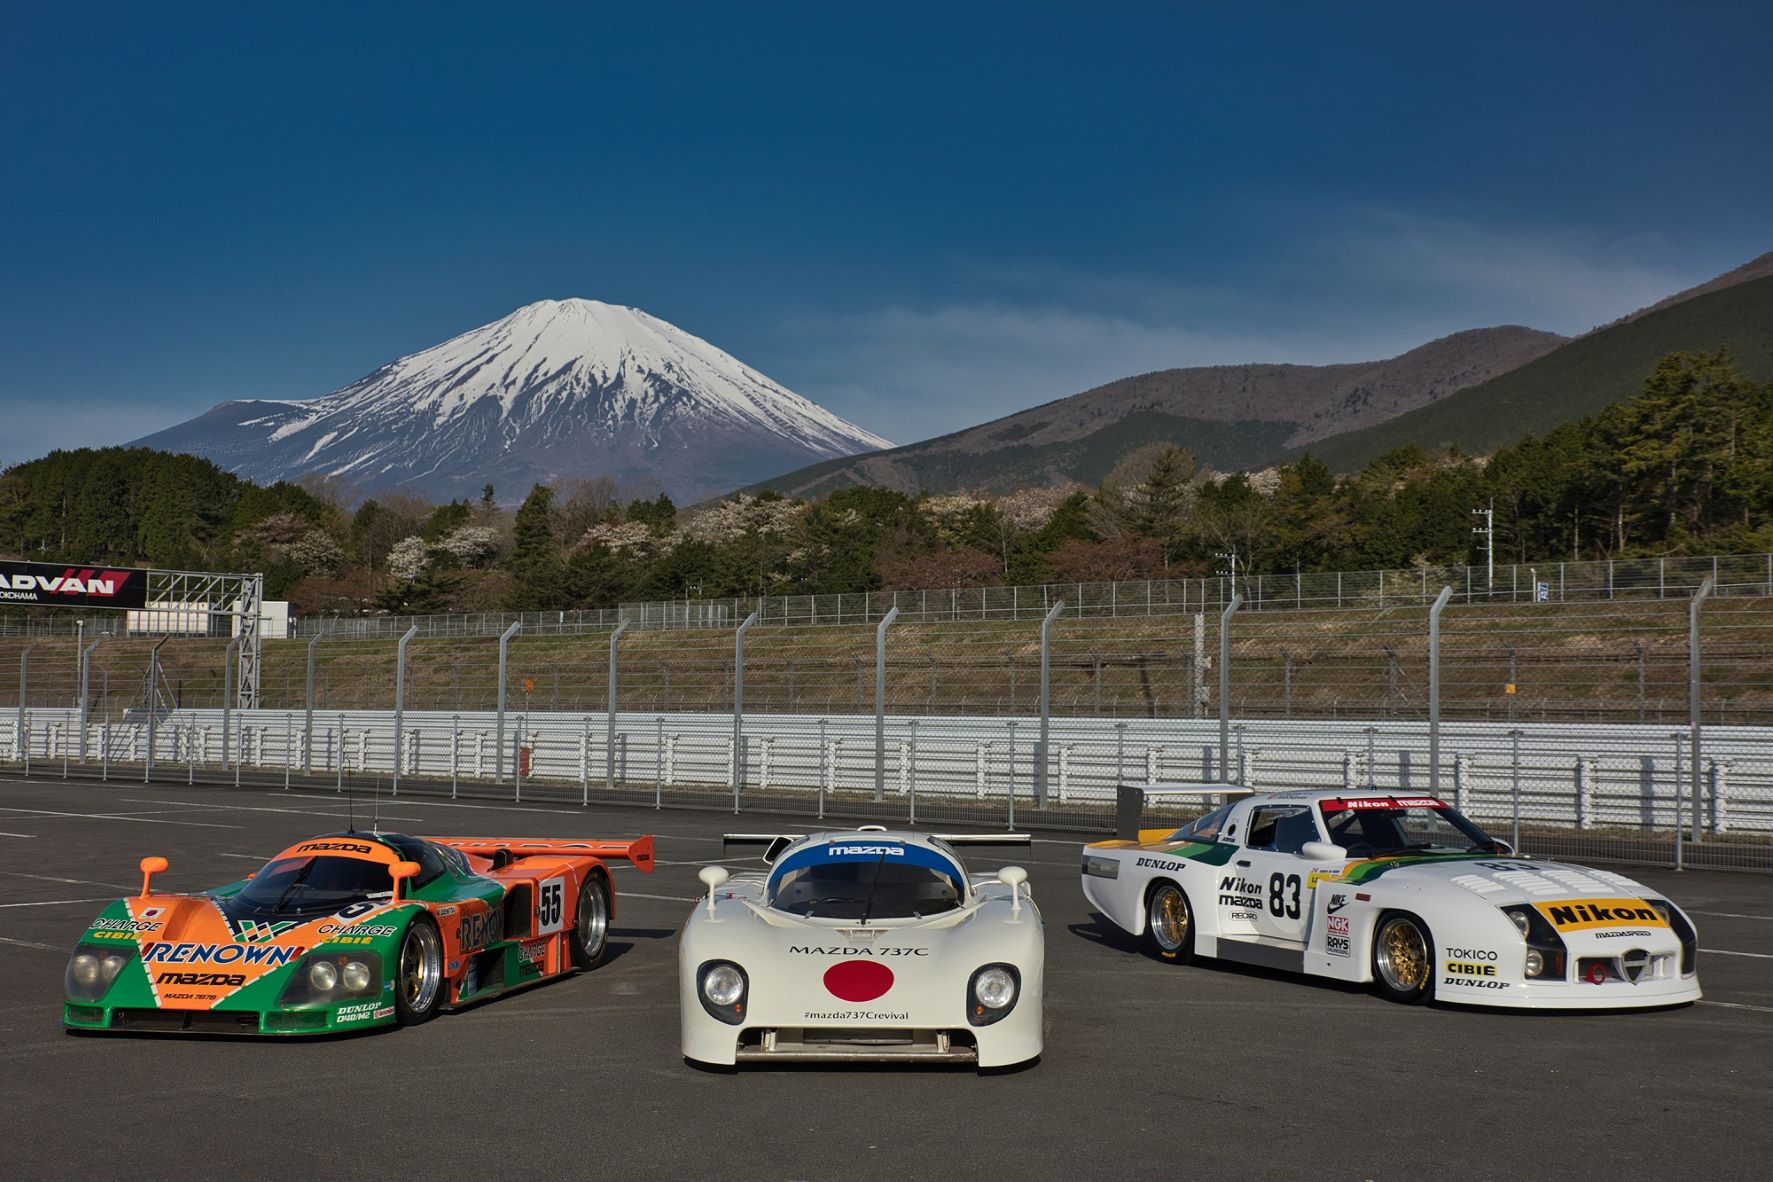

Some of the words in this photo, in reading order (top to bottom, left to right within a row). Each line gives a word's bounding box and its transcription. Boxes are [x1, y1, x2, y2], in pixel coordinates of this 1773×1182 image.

[0, 591, 38, 600] OKOHAMA
[296, 842, 372, 854] mazda
[828, 846, 905, 857] mazda
[1135, 857, 1186, 872] DUNLOP
[1219, 876, 1262, 894] Nikon
[1218, 894, 1263, 910] mazda
[1269, 871, 1302, 921] 83
[1330, 893, 1348, 906] NIKE
[541, 883, 561, 926] 55
[1548, 904, 1658, 925] Nikon
[89, 918, 163, 932] CHARGE
[318, 924, 398, 937] CHARGE
[1327, 916, 1349, 931] NGK
[1327, 936, 1349, 950] RAYS
[143, 943, 296, 965] RENOWN
[790, 946, 873, 955] MAZDA
[880, 948, 929, 956] 737C
[1446, 947, 1498, 961] TOKICO
[156, 972, 247, 987] mazda
[1444, 977, 1511, 990] DUNLOP
[337, 1002, 382, 1015] DUNLOP
[804, 1011, 909, 1020] #mazda737Crevival
